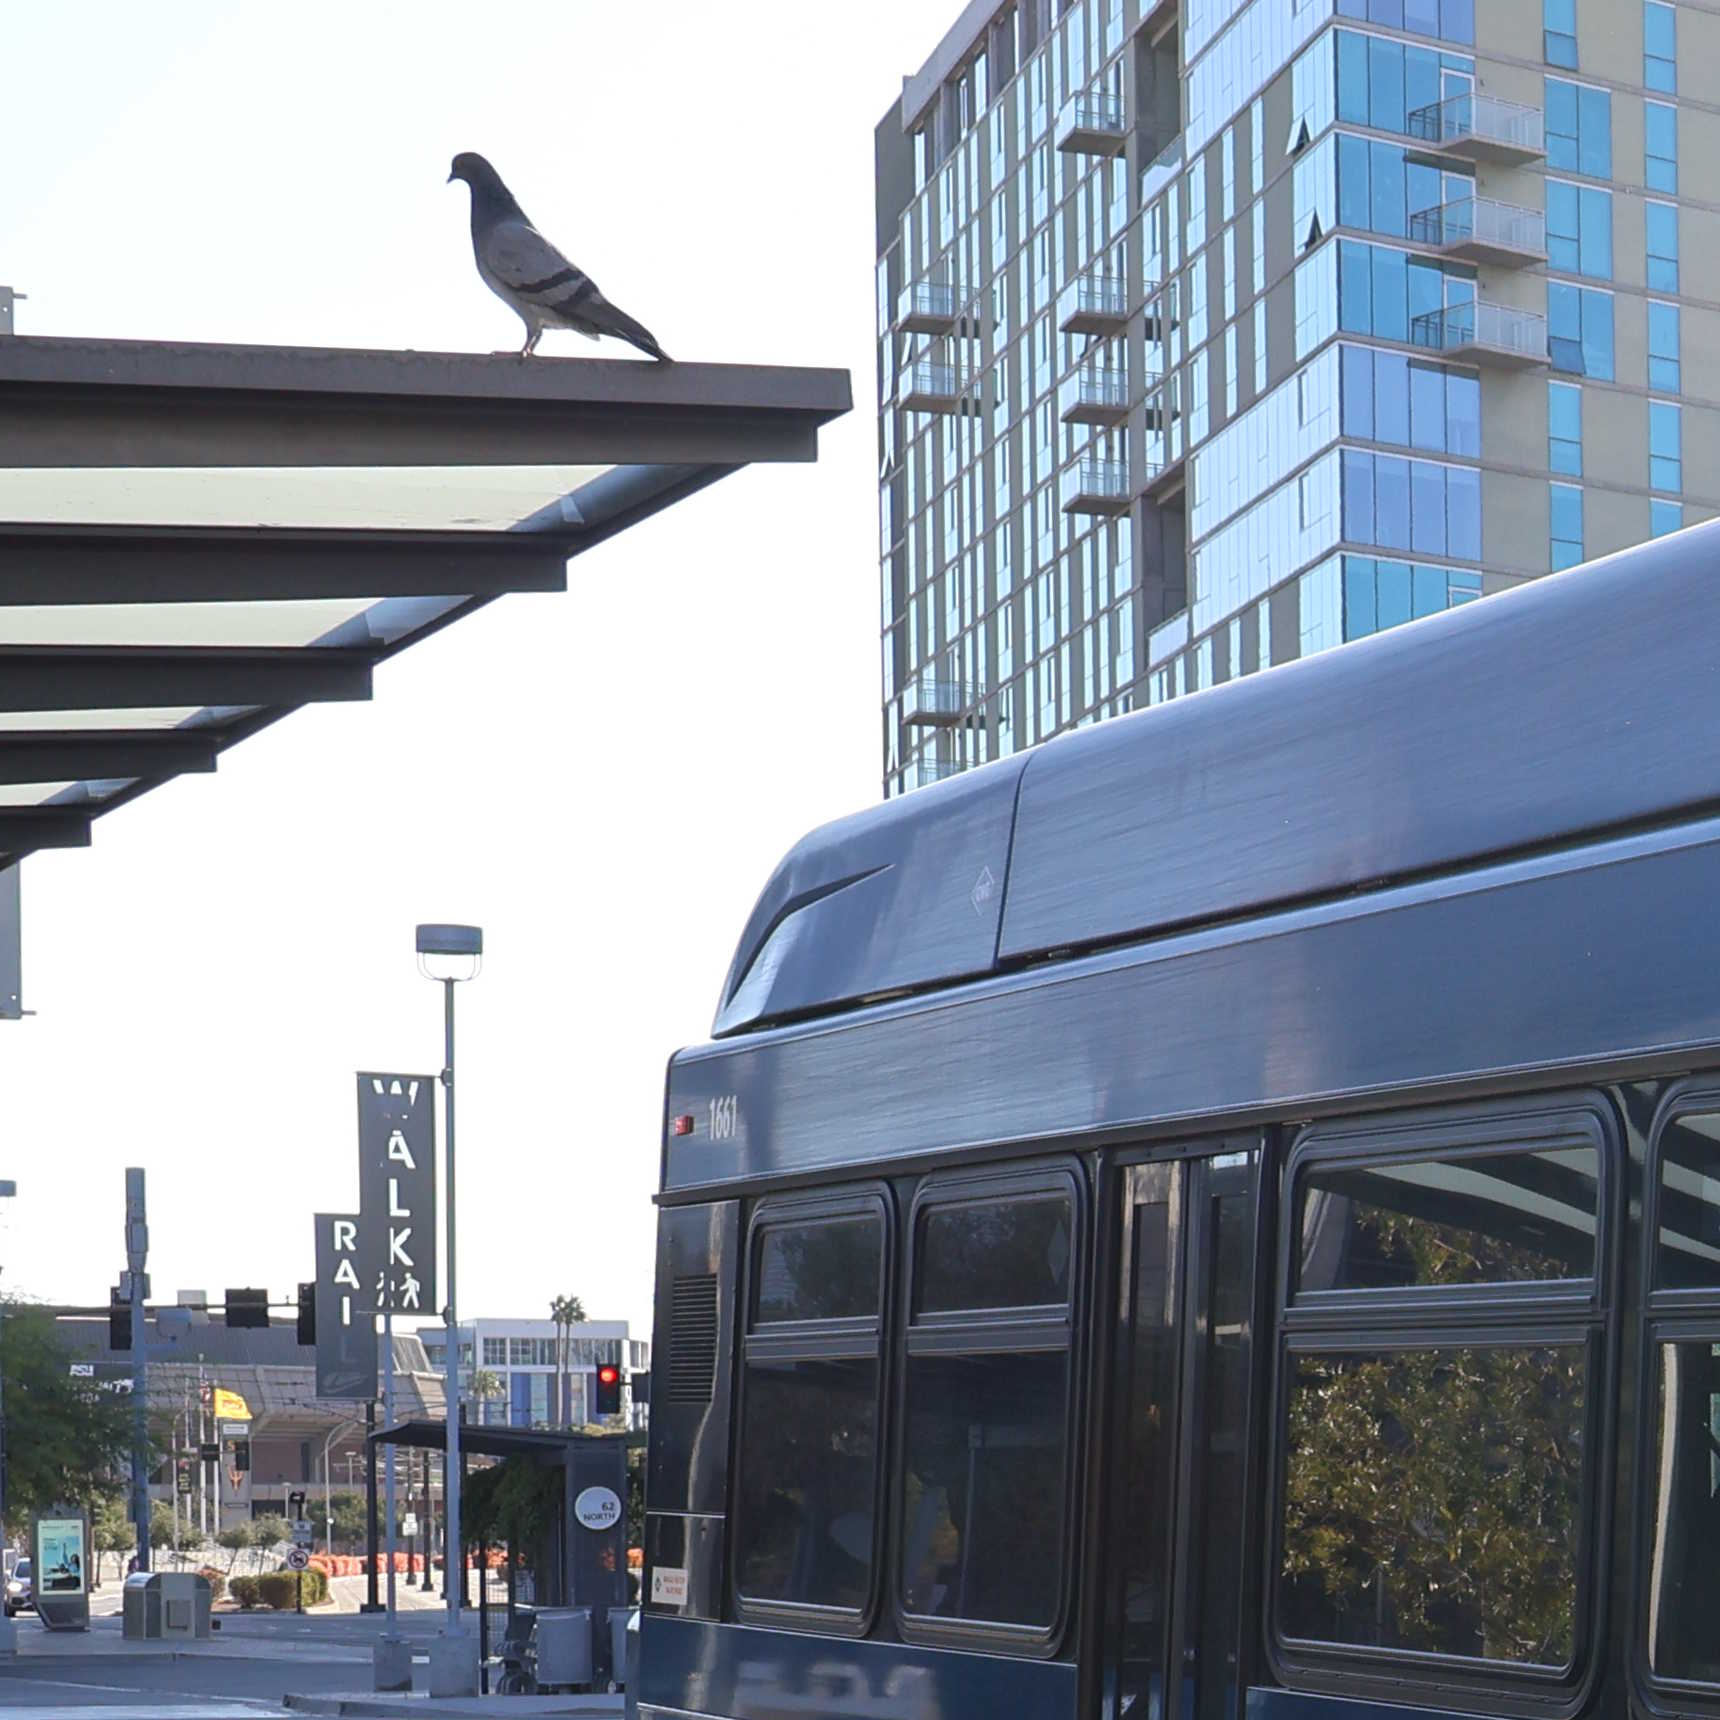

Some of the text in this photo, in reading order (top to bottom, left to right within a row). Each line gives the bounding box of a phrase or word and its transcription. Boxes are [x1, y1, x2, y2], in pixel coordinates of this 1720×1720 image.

[709, 1095, 737, 1140] 1661
[333, 1220, 361, 1363] RAIL
[583, 1512, 616, 1521] NORTH
[601, 1502, 615, 1512] 62
